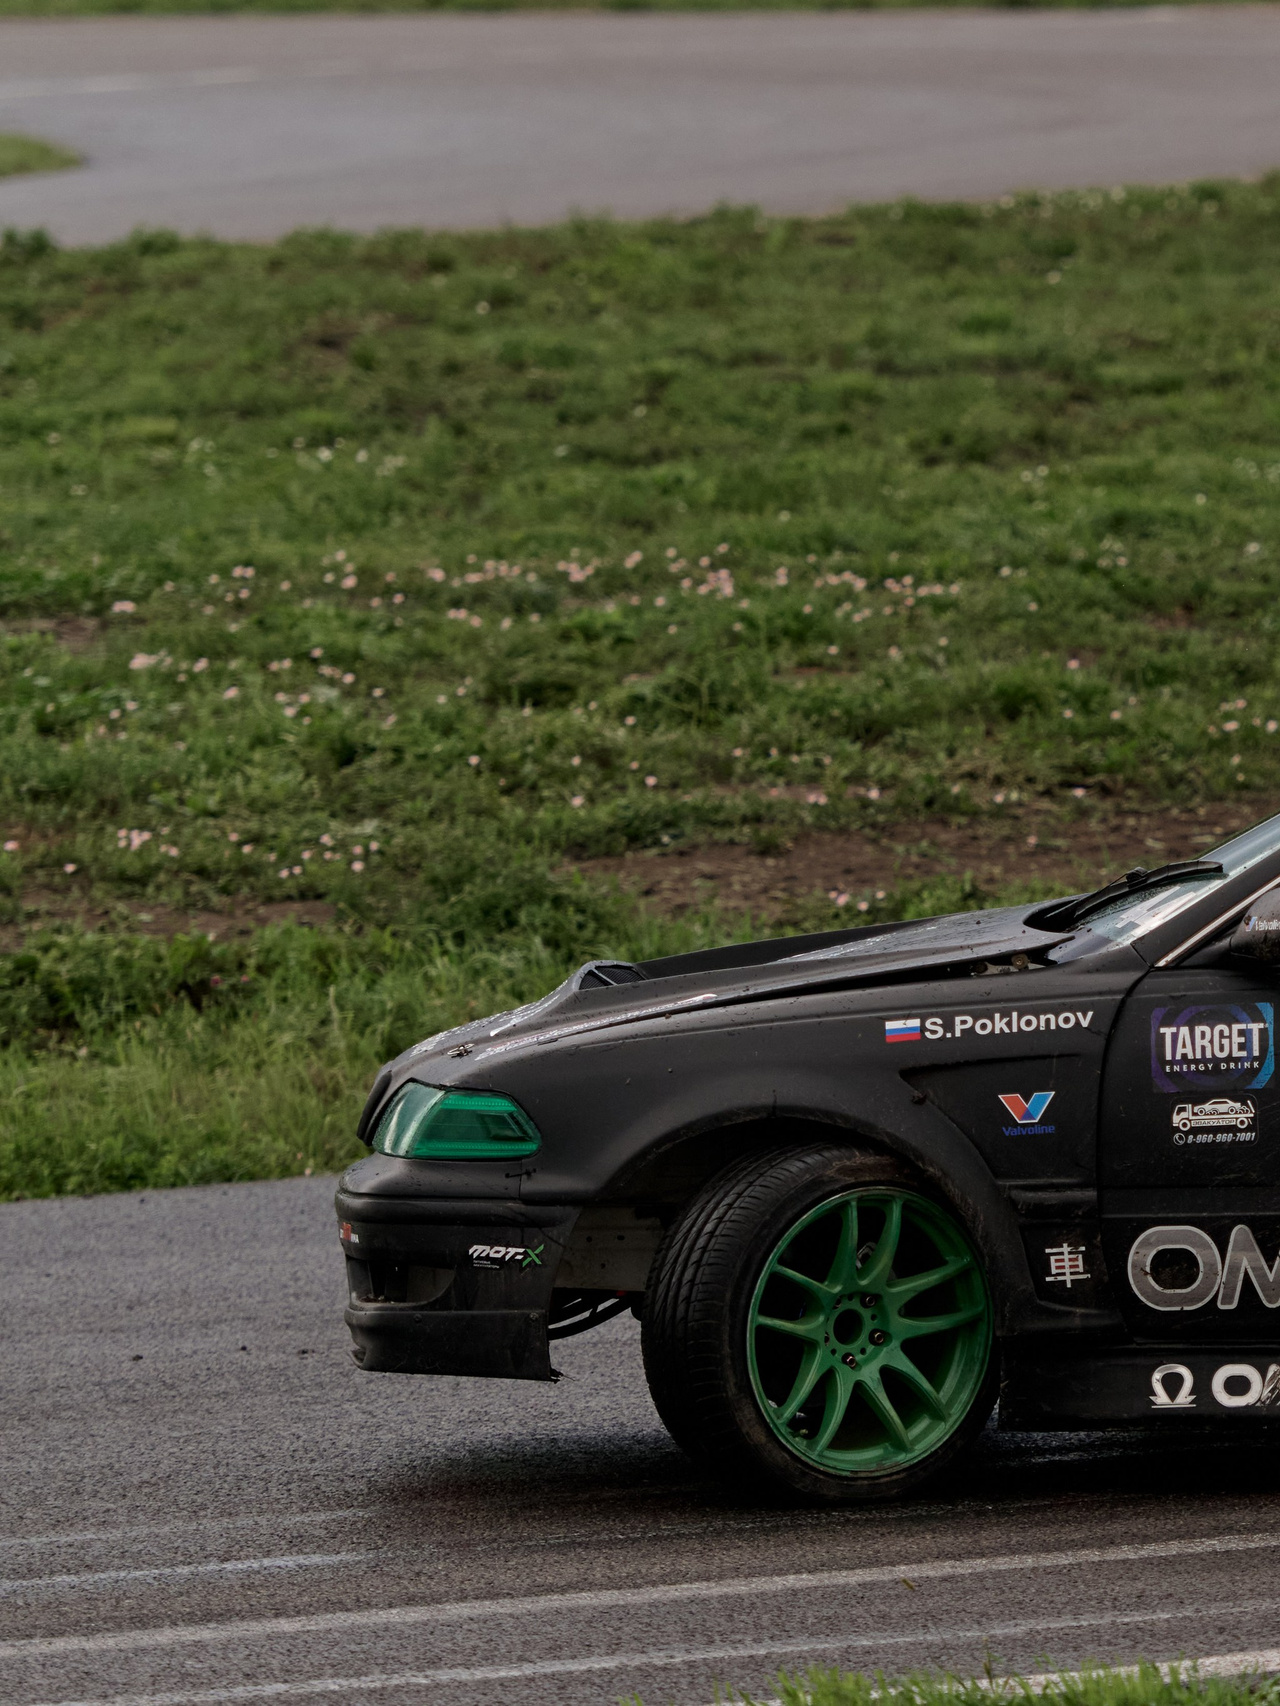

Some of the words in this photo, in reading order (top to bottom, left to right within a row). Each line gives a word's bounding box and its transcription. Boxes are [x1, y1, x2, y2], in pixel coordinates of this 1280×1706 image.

[924, 1011, 1094, 1040] S.Poklonov
[1160, 1023, 1264, 1061] TARGET
[1166, 1063, 1213, 1073] ENERGY
[1220, 1061, 1260, 1070] DRINK
[1002, 1124, 1055, 1137] Valvoline
[1187, 1132, 1256, 1144] 8-960-960-7001
[1045, 1243, 1091, 1288] 車
